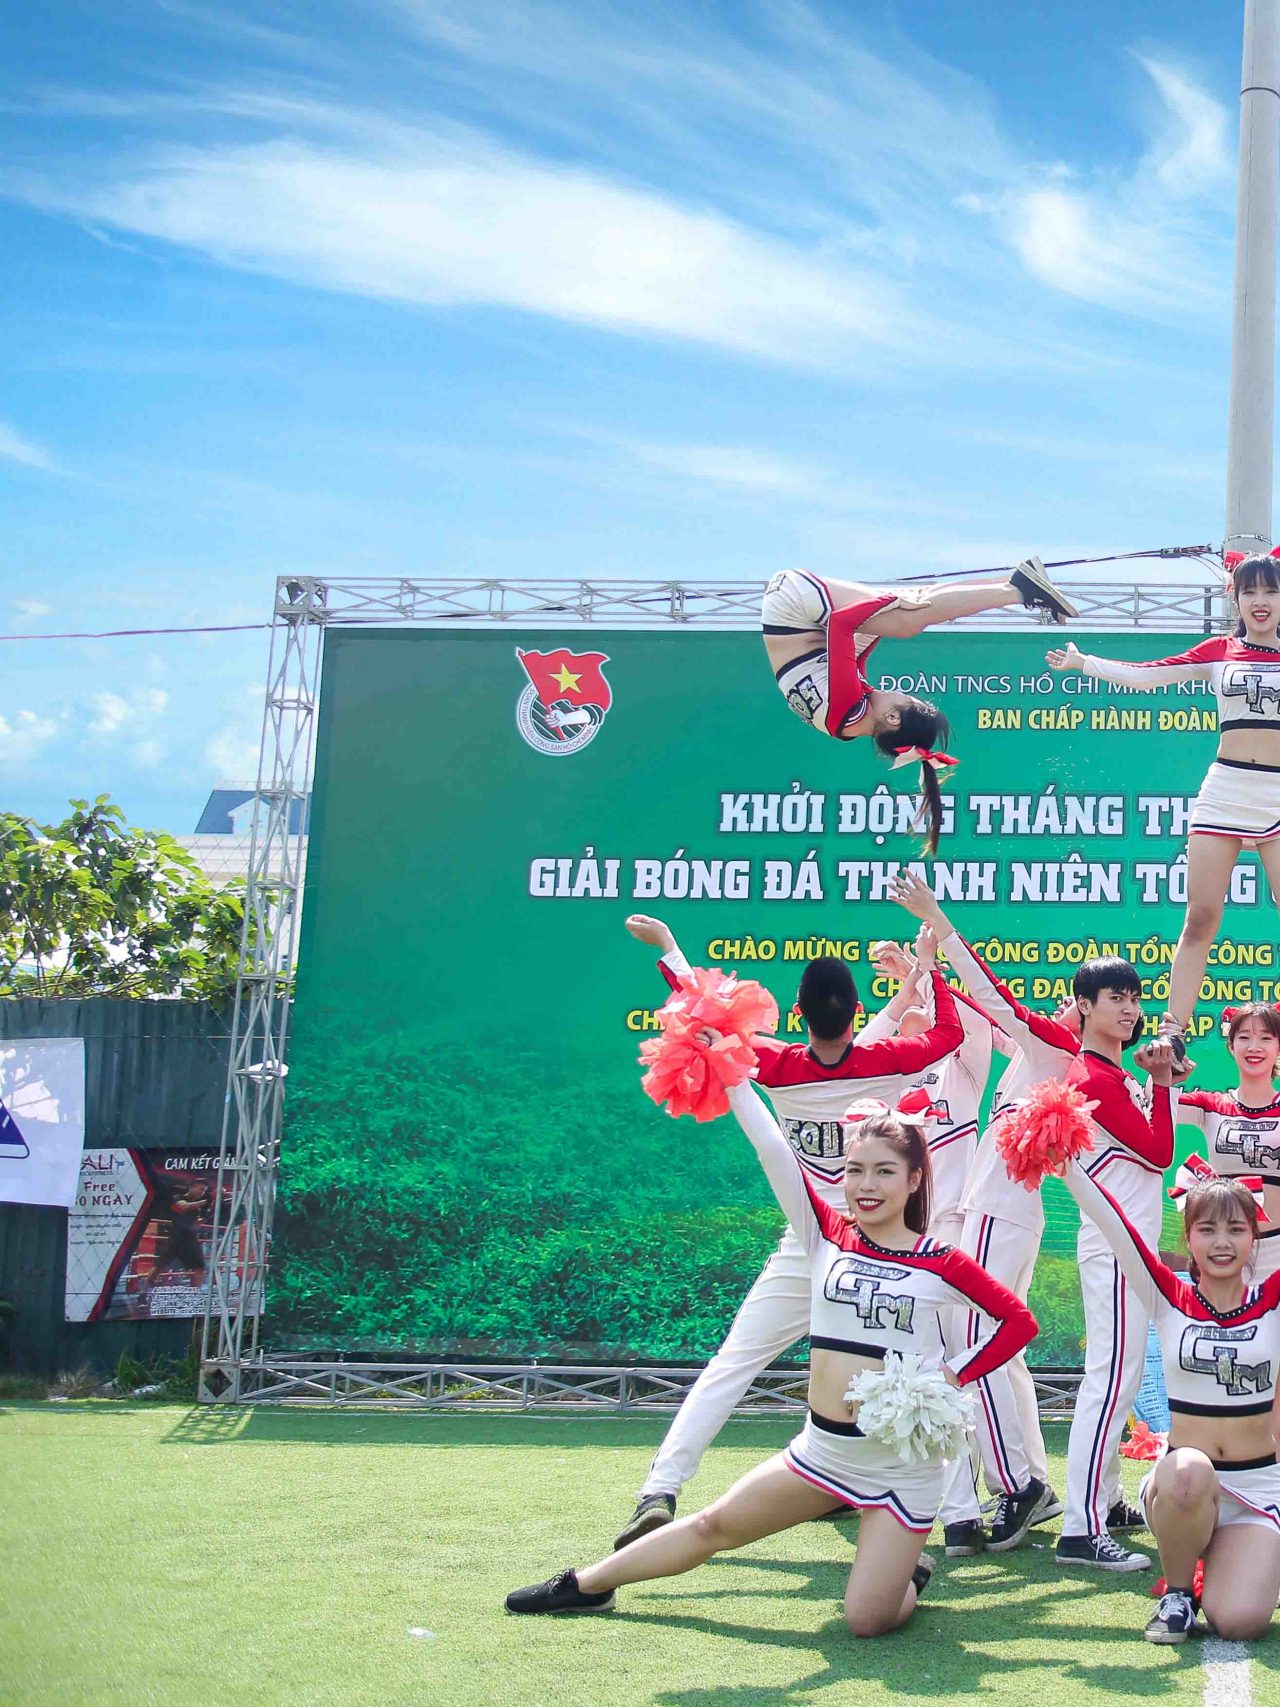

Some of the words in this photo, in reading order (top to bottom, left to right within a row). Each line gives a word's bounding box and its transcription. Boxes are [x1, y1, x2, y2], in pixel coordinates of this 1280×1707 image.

[878, 671, 947, 694] ĐOÀN
[953, 674, 1012, 695] TNCS
[1019, 671, 1055, 695] HỒ
[977, 708, 1022, 730] BAN
[1027, 703, 1086, 731] CHẤP
[1091, 705, 1153, 731] HÀNH
[1157, 705, 1217, 732] ĐOÀN
[718, 781, 825, 834] KHỞI
[837, 783, 956, 846] ĐỘNG
[968, 784, 1125, 835] THÁNG
[529, 847, 621, 899] GIẢI
[632, 848, 751, 900] BÓNG
[762, 849, 824, 901] ĐÁ
[837, 861, 997, 902] THANH
[1010, 853, 1122, 903] NIÊN
[1135, 845, 1257, 904] TỔG
[707, 936, 777, 961] CHÀO
[783, 937, 861, 962] MỪNG
[1126, 936, 1179, 966] TỔN
[1198, 976, 1252, 1002] ÔNG
[164, 1157, 188, 1171] CAM
